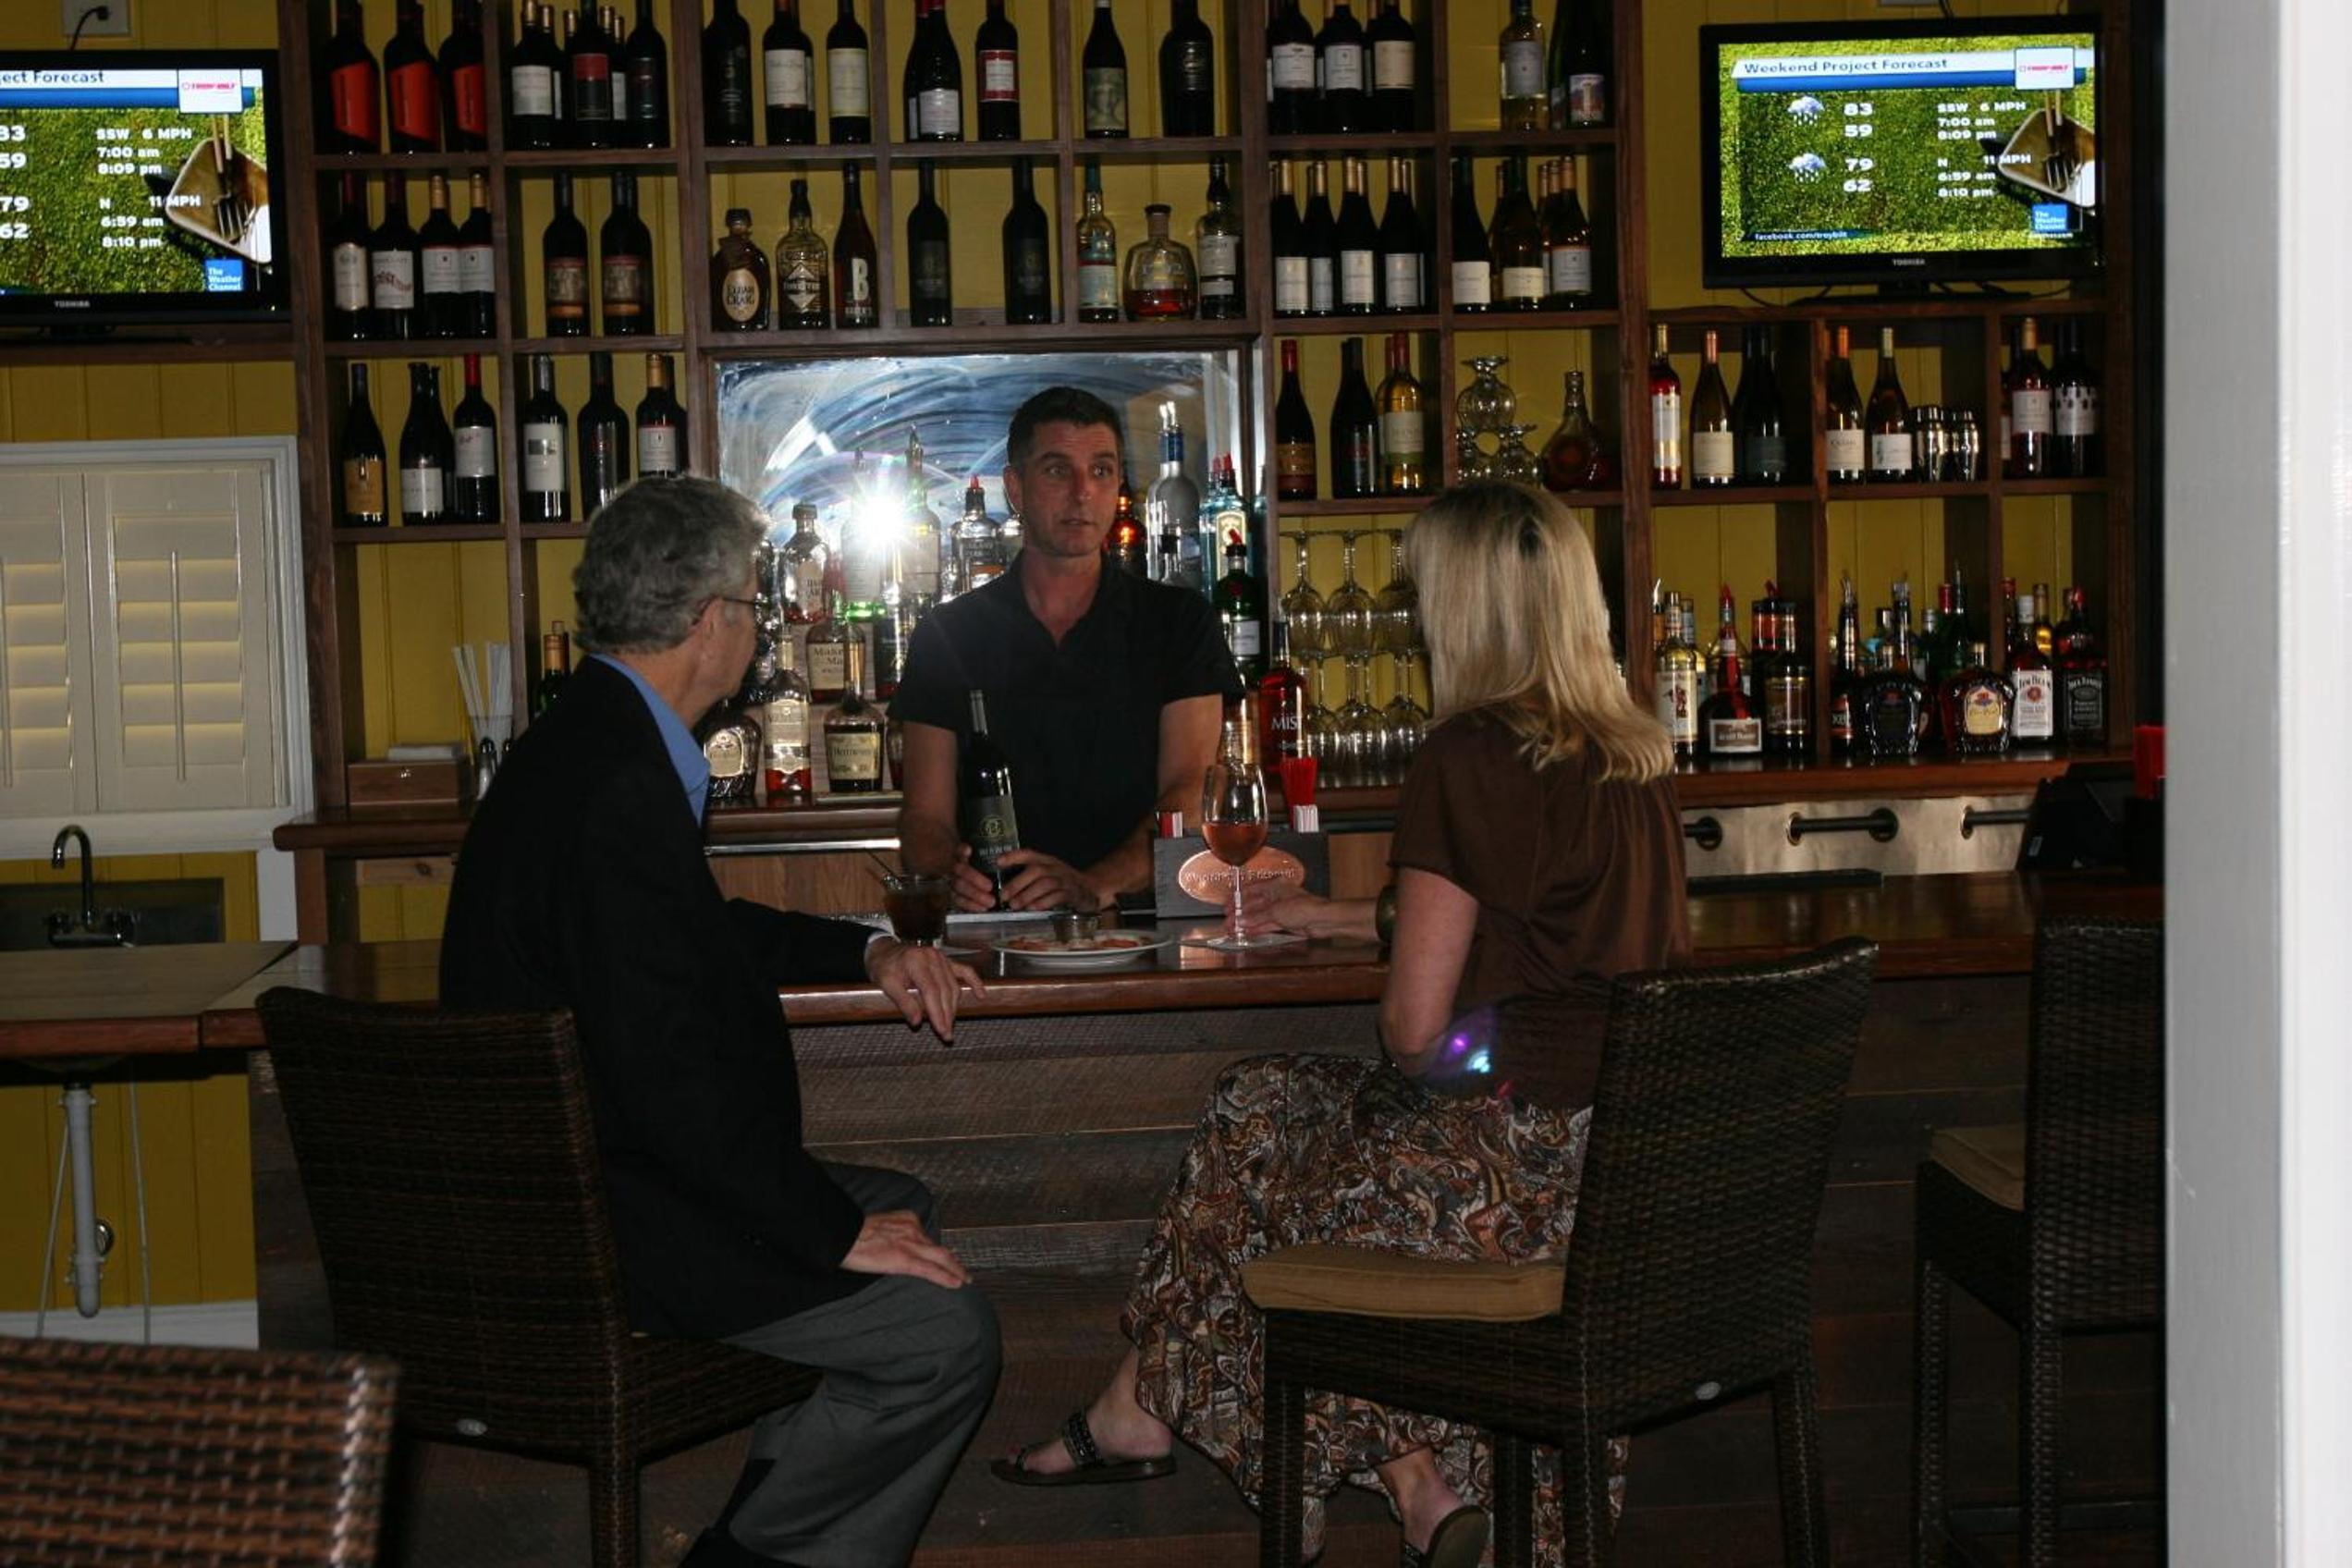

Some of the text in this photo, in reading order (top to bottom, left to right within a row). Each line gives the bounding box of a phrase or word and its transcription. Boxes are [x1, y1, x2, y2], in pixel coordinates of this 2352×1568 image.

[1745, 58, 1948, 73] Weekend Project Forecast
[33, 69, 104, 83] Forecast
[1844, 103, 1873, 116] 83
[1938, 102, 2026, 113] SSW 6 MPH
[1938, 117, 1996, 127] 7:00 am
[95, 128, 192, 140] SSW 6 MPH
[1844, 124, 1873, 137] 59
[1938, 130, 1997, 140] 8:09 pm
[96, 146, 160, 158] 7:00 am
[1844, 157, 1874, 171] 79
[1938, 154, 2031, 167] N 11 MPH
[97, 163, 163, 176] 8:09 pm
[1938, 172, 1996, 181] 6:59 am
[1844, 179, 1873, 192] 62
[1938, 188, 1994, 198] 8:10 pm
[0, 195, 30, 212] 79
[99, 195, 202, 209] N 11 MPH
[101, 215, 165, 227] 6:59 am
[0, 222, 30, 239] 62
[102, 236, 163, 248] 8:10 pm
[851, 258, 869, 300] B
[727, 295, 754, 306] CRAIG
